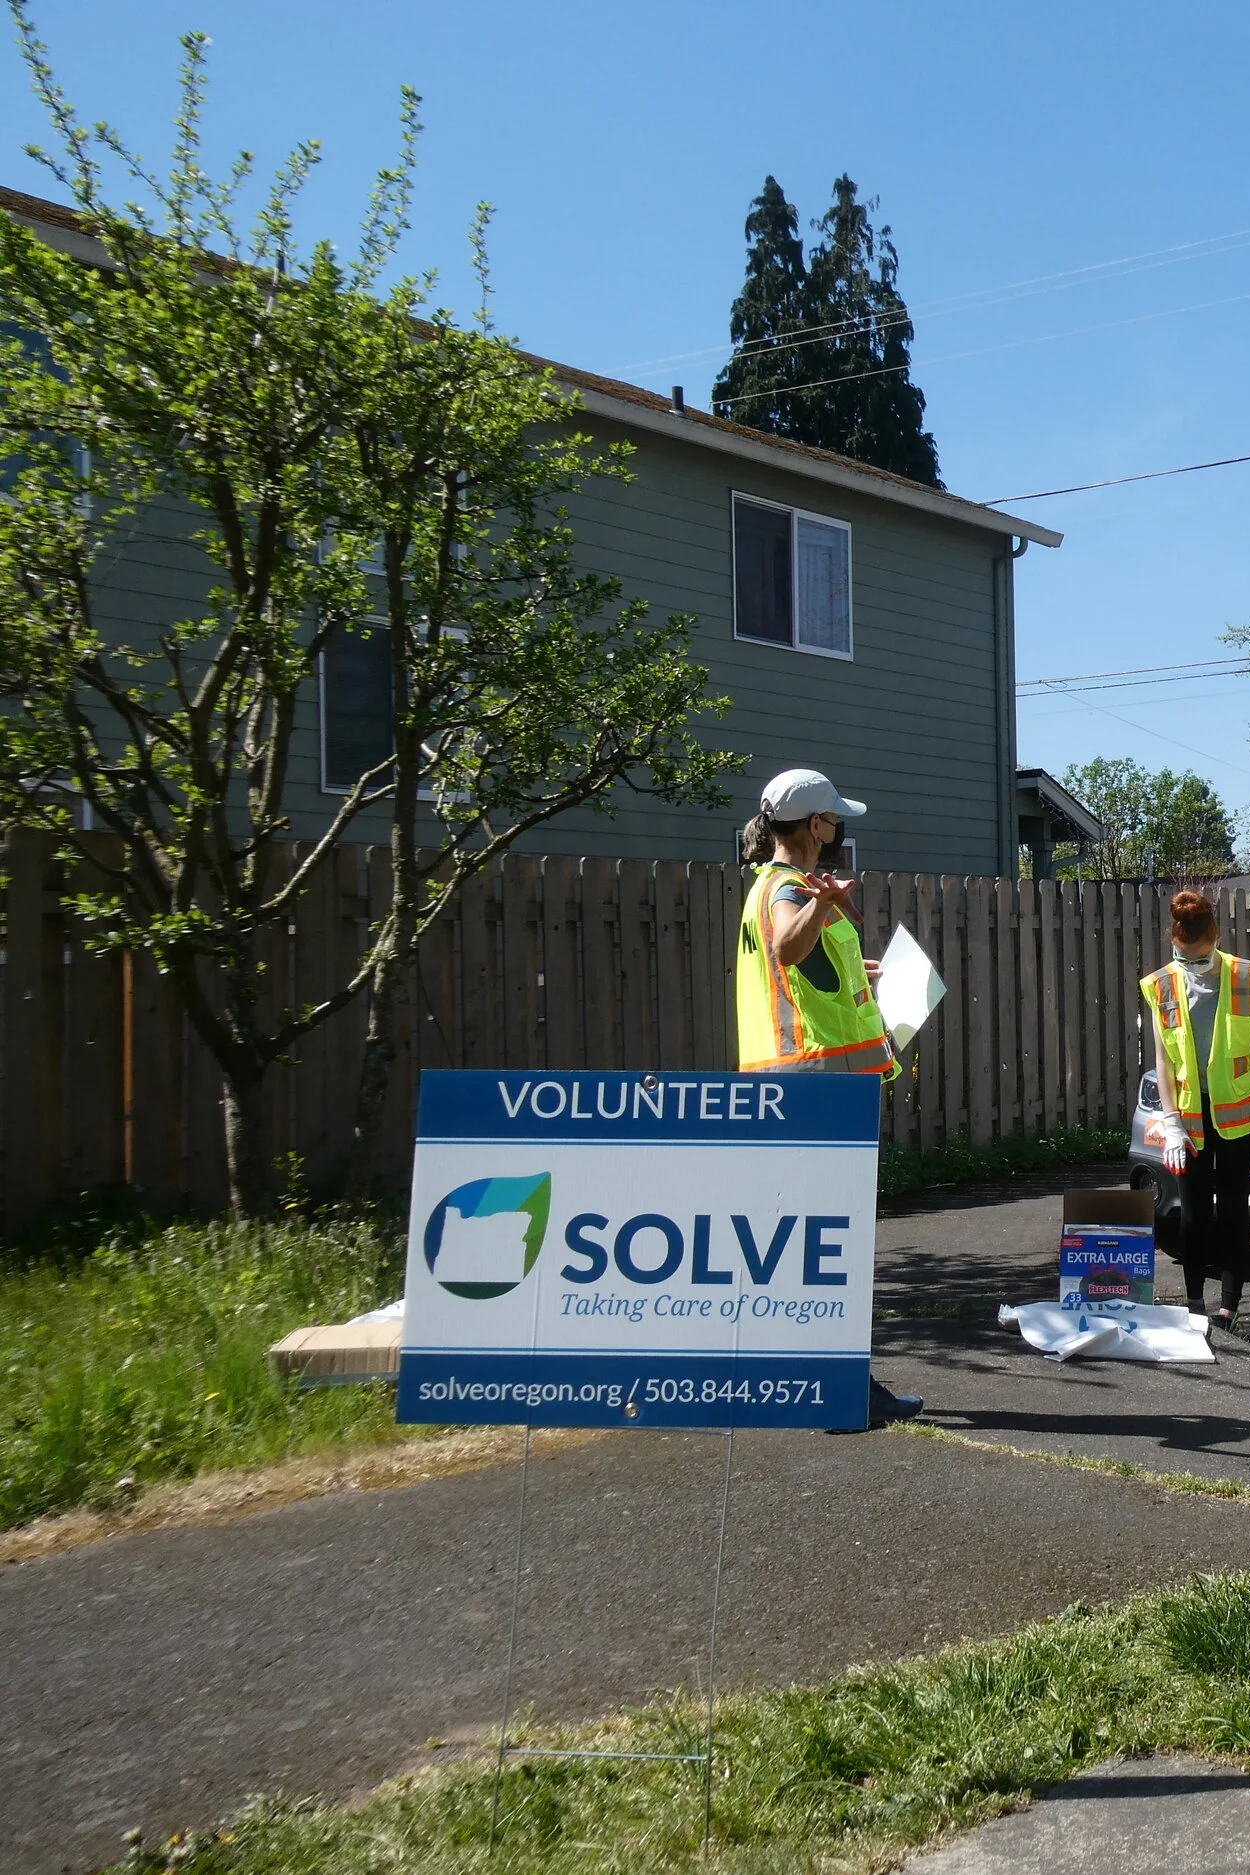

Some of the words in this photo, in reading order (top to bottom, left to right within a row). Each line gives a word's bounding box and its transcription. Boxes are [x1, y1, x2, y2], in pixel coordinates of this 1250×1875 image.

[498, 1081, 785, 1120] VOLUNTEER
[560, 1213, 850, 1286] SOLVE
[1067, 1252, 1106, 1263] EXTRA
[1109, 1252, 1149, 1264] LARGE
[1133, 1267, 1151, 1276] Bags
[561, 1293, 648, 1322] Taking
[653, 1295, 713, 1318] Care
[720, 1295, 750, 1324] of
[752, 1297, 845, 1325] Oregon
[1069, 1293, 1082, 1302] 33
[418, 1376, 623, 1407] solveoregon.org
[644, 1379, 824, 1405] 503.844.9571
